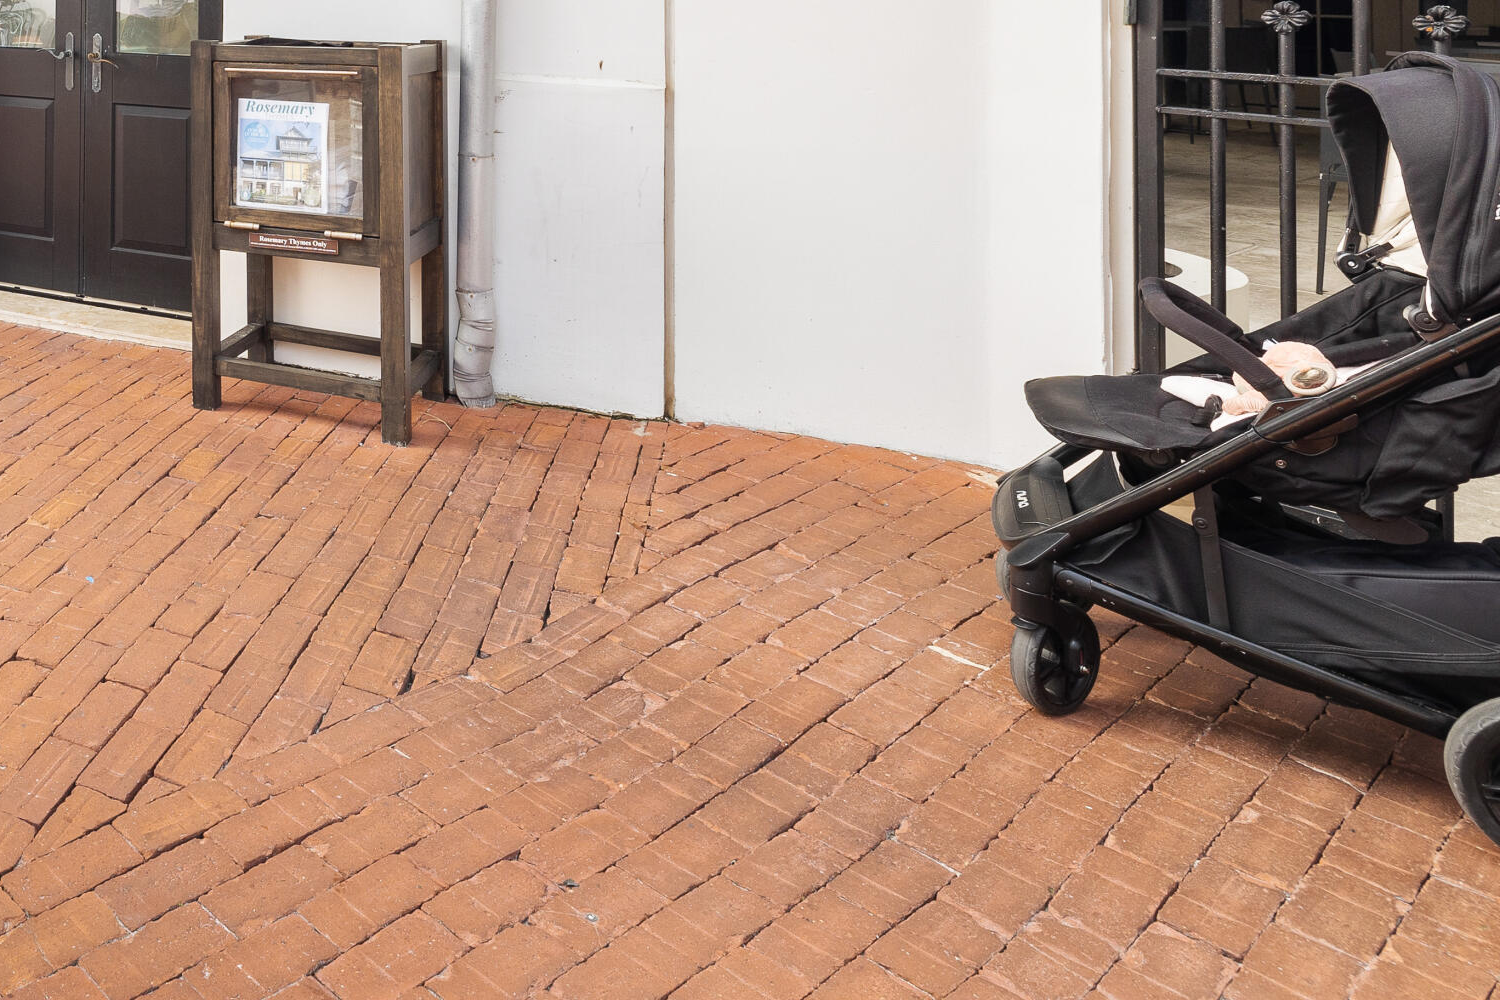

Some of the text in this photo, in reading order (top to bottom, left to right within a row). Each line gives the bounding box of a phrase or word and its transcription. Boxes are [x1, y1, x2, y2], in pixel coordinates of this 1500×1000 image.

[245, 100, 316, 118] Rosemary
[259, 235, 288, 247] Rosemary
[288, 238, 312, 247] Thymes
[312, 240, 328, 249] Only
